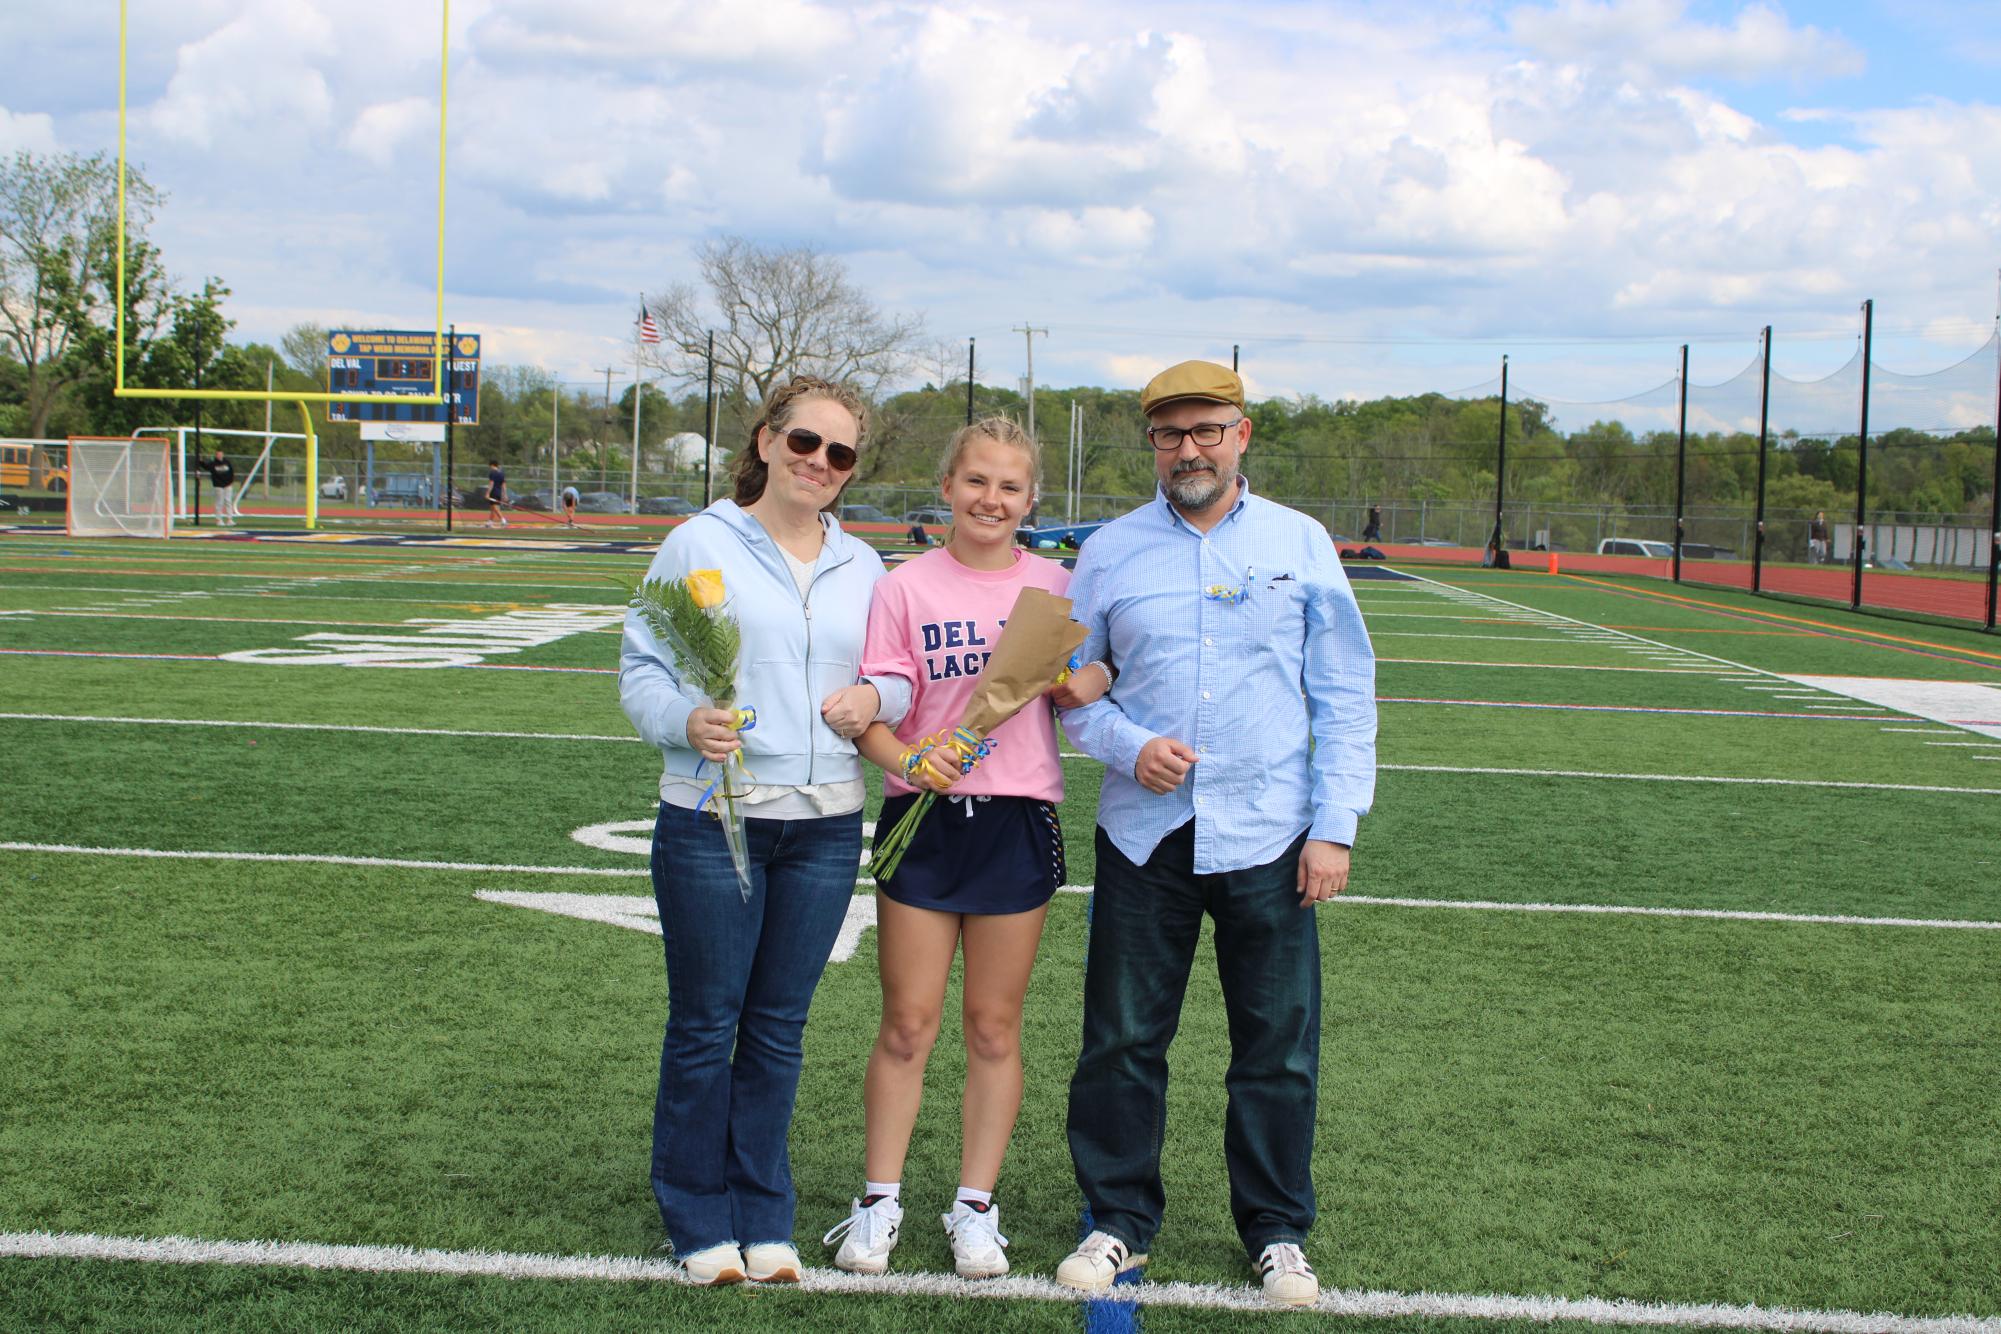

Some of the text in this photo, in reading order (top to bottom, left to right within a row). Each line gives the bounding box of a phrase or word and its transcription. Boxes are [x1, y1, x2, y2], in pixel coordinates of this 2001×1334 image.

[352, 334, 386, 344] WELCOME
[386, 335, 395, 344] TO
[397, 335, 433, 345] DELAWARE
[331, 358, 362, 369] DEL VAL
[447, 361, 477, 372] GUEST
[920, 620, 986, 652] DEL
